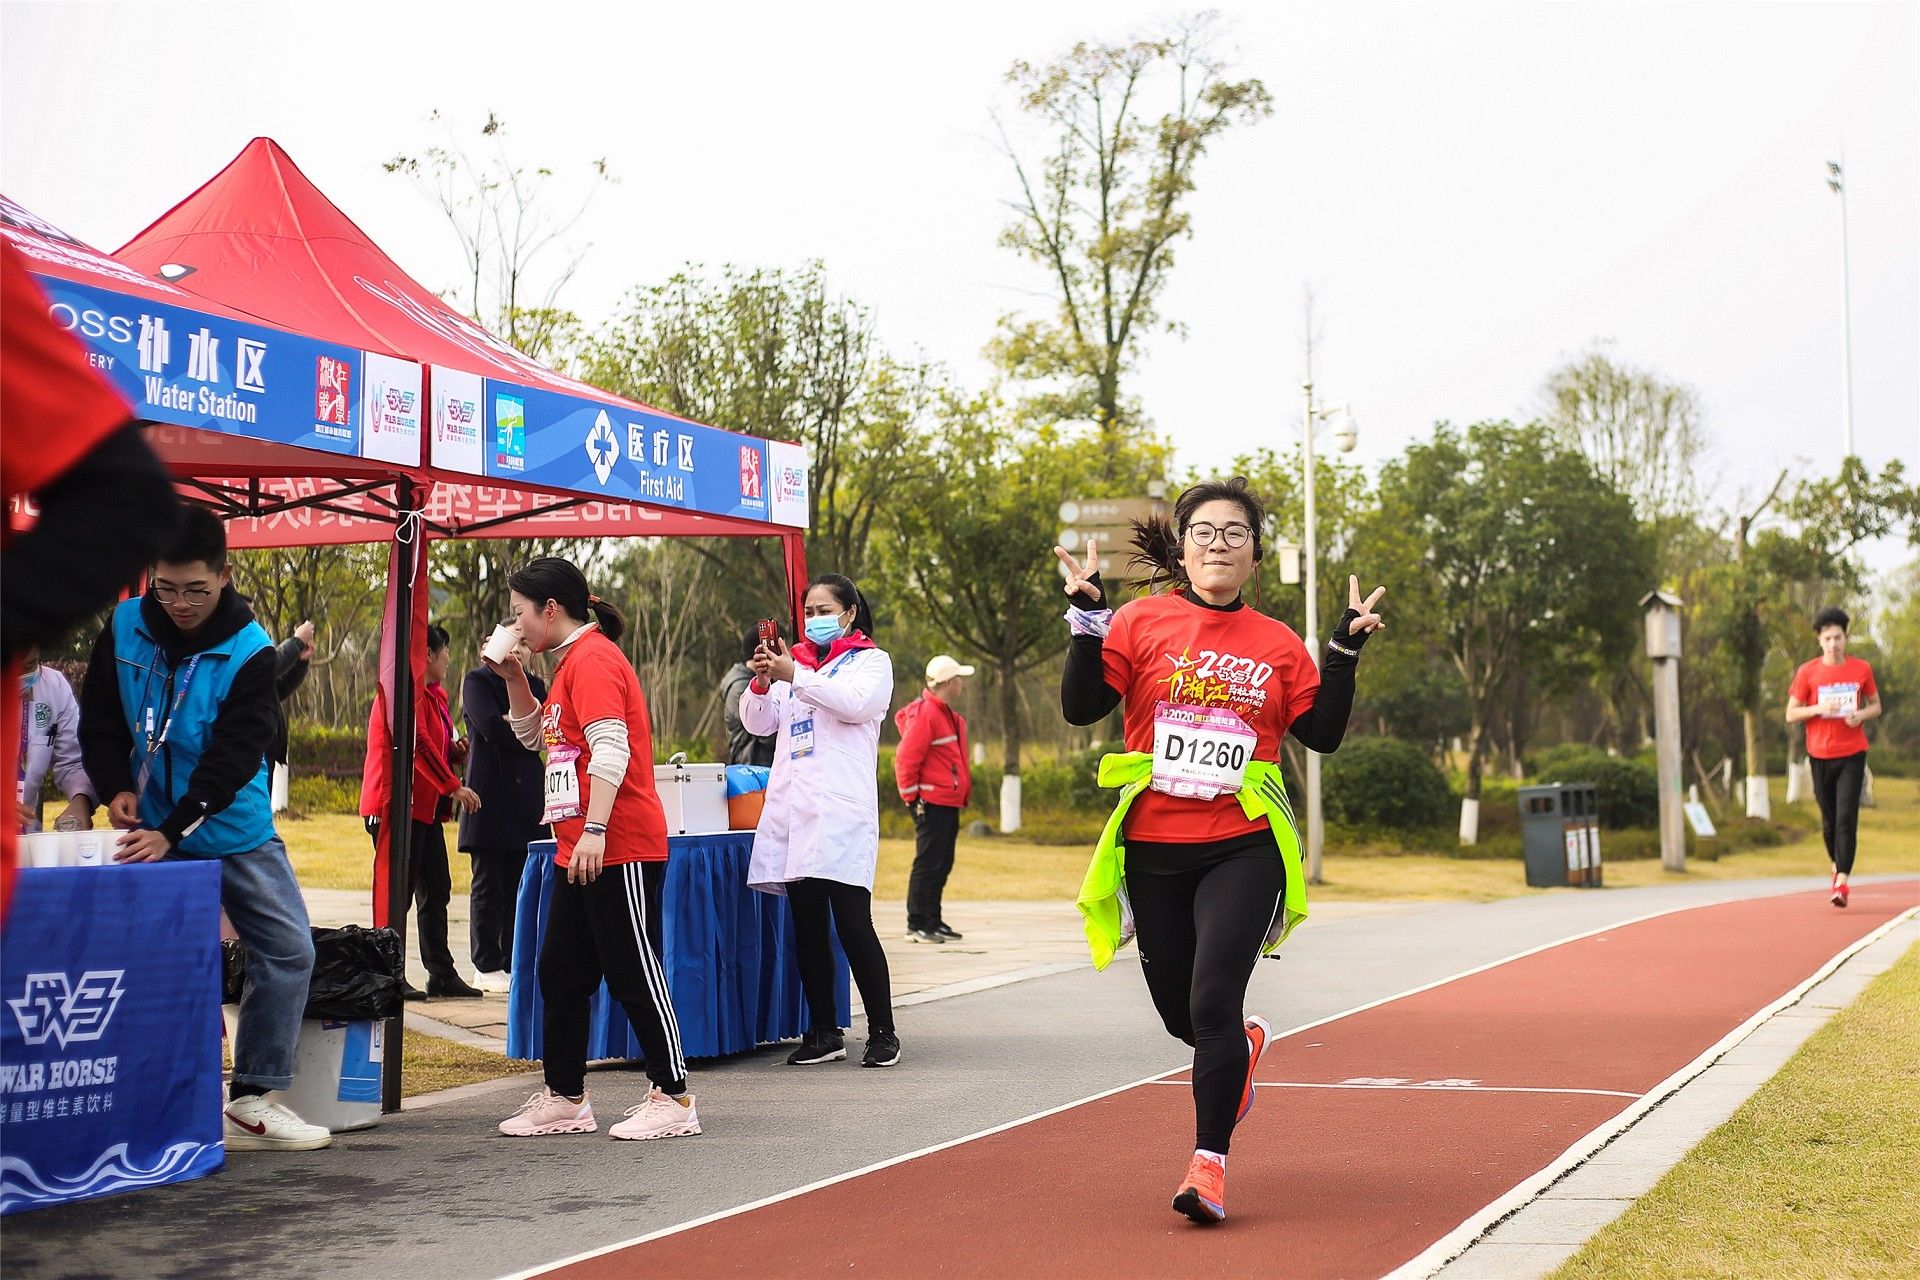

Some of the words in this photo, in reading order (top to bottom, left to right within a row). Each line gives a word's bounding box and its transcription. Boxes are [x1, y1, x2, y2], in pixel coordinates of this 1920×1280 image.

[84, 350, 115, 371] ERY
[137, 313, 267, 394] 补水区
[144, 374, 196, 413] Water
[198, 385, 257, 424] Station
[627, 422, 695, 473] 医疗区
[640, 469, 664, 499] First
[665, 475, 684, 501] Aid
[1181, 674, 1231, 703] 湘江
[1195, 650, 1273, 689] 2020
[1164, 734, 1245, 771] D1260
[0, 1063, 45, 1094] WAR
[47, 1056, 118, 1090] HORSE
